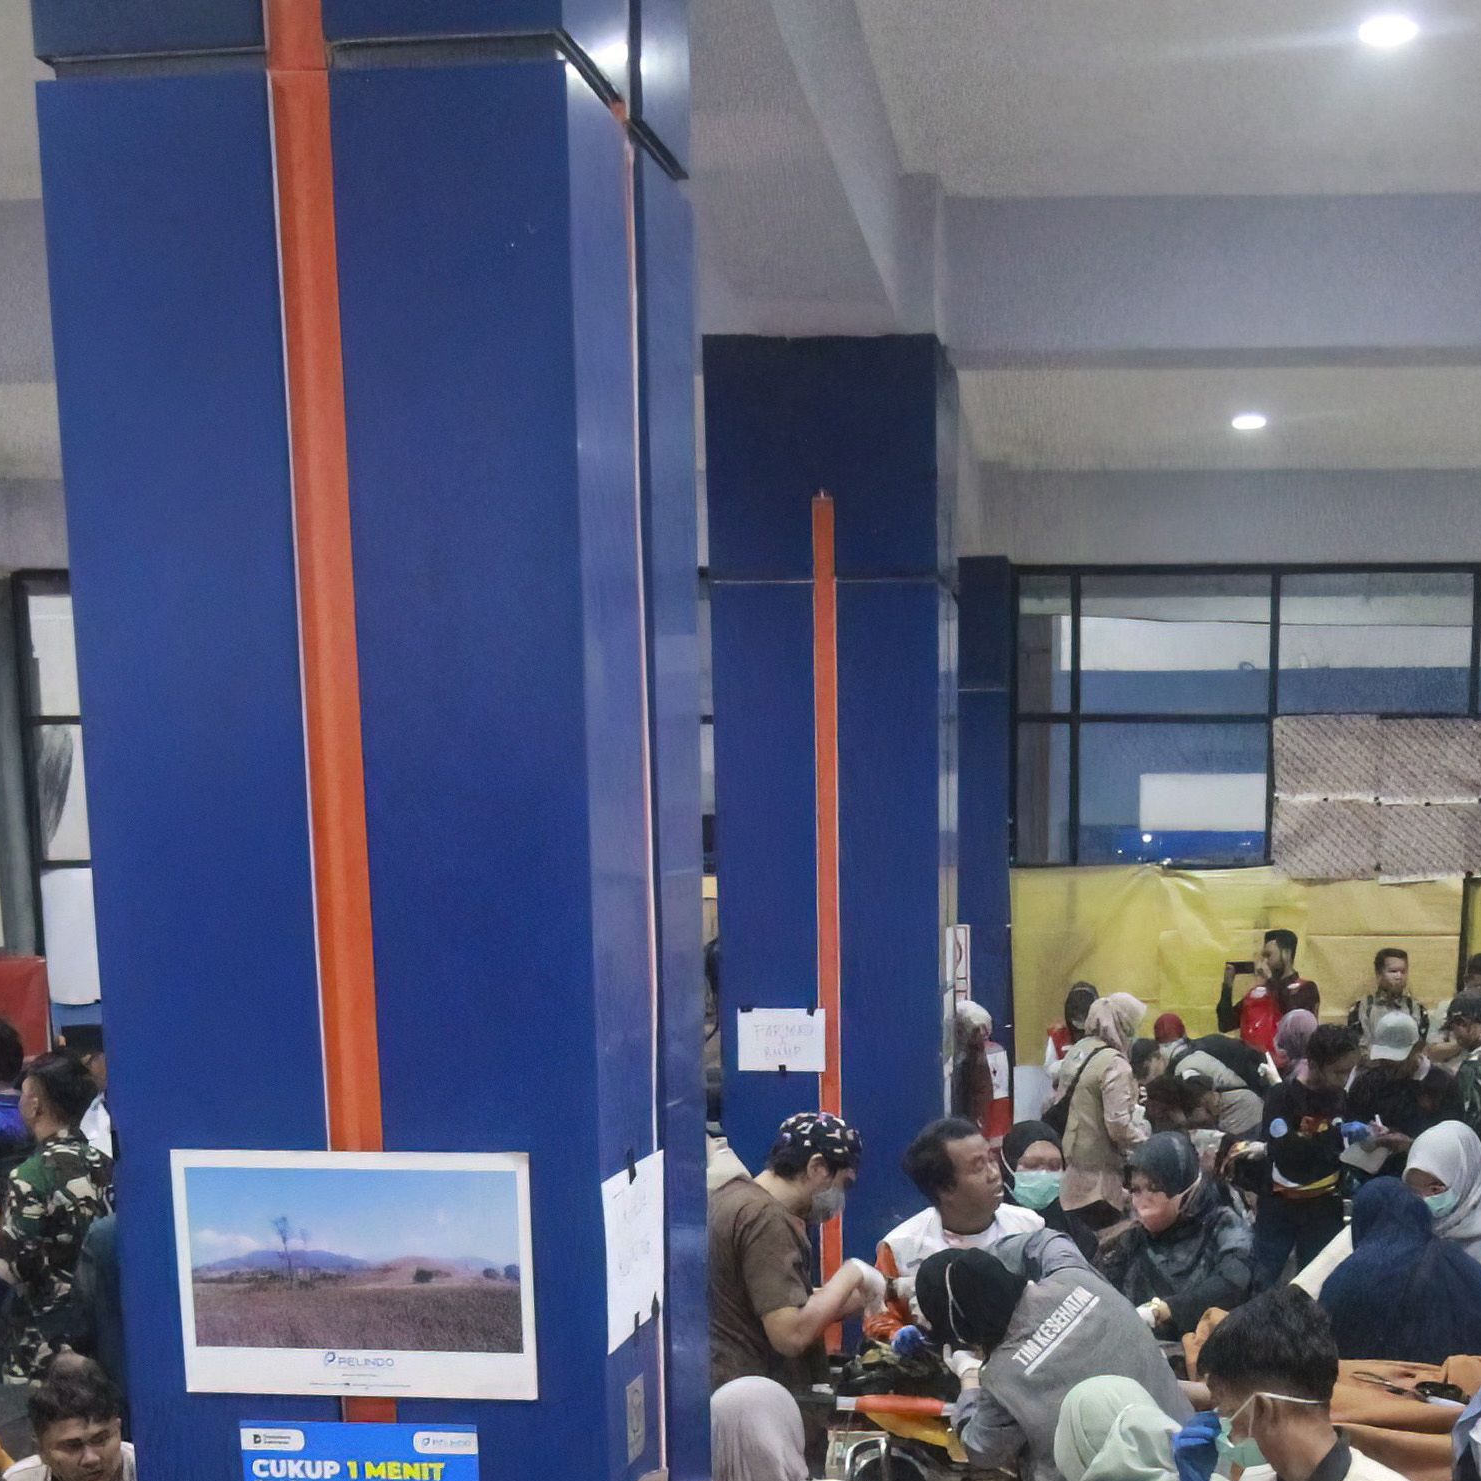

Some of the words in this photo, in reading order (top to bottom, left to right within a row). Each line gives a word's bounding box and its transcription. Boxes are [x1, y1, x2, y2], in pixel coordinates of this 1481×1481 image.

[1012, 1339, 1042, 1366] TIM
[1032, 1286, 1094, 1347] KESEHATAN
[252, 1459, 341, 1480] CUKUP
[347, 1461, 358, 1479] 1
[364, 1461, 446, 1481] MENIT
